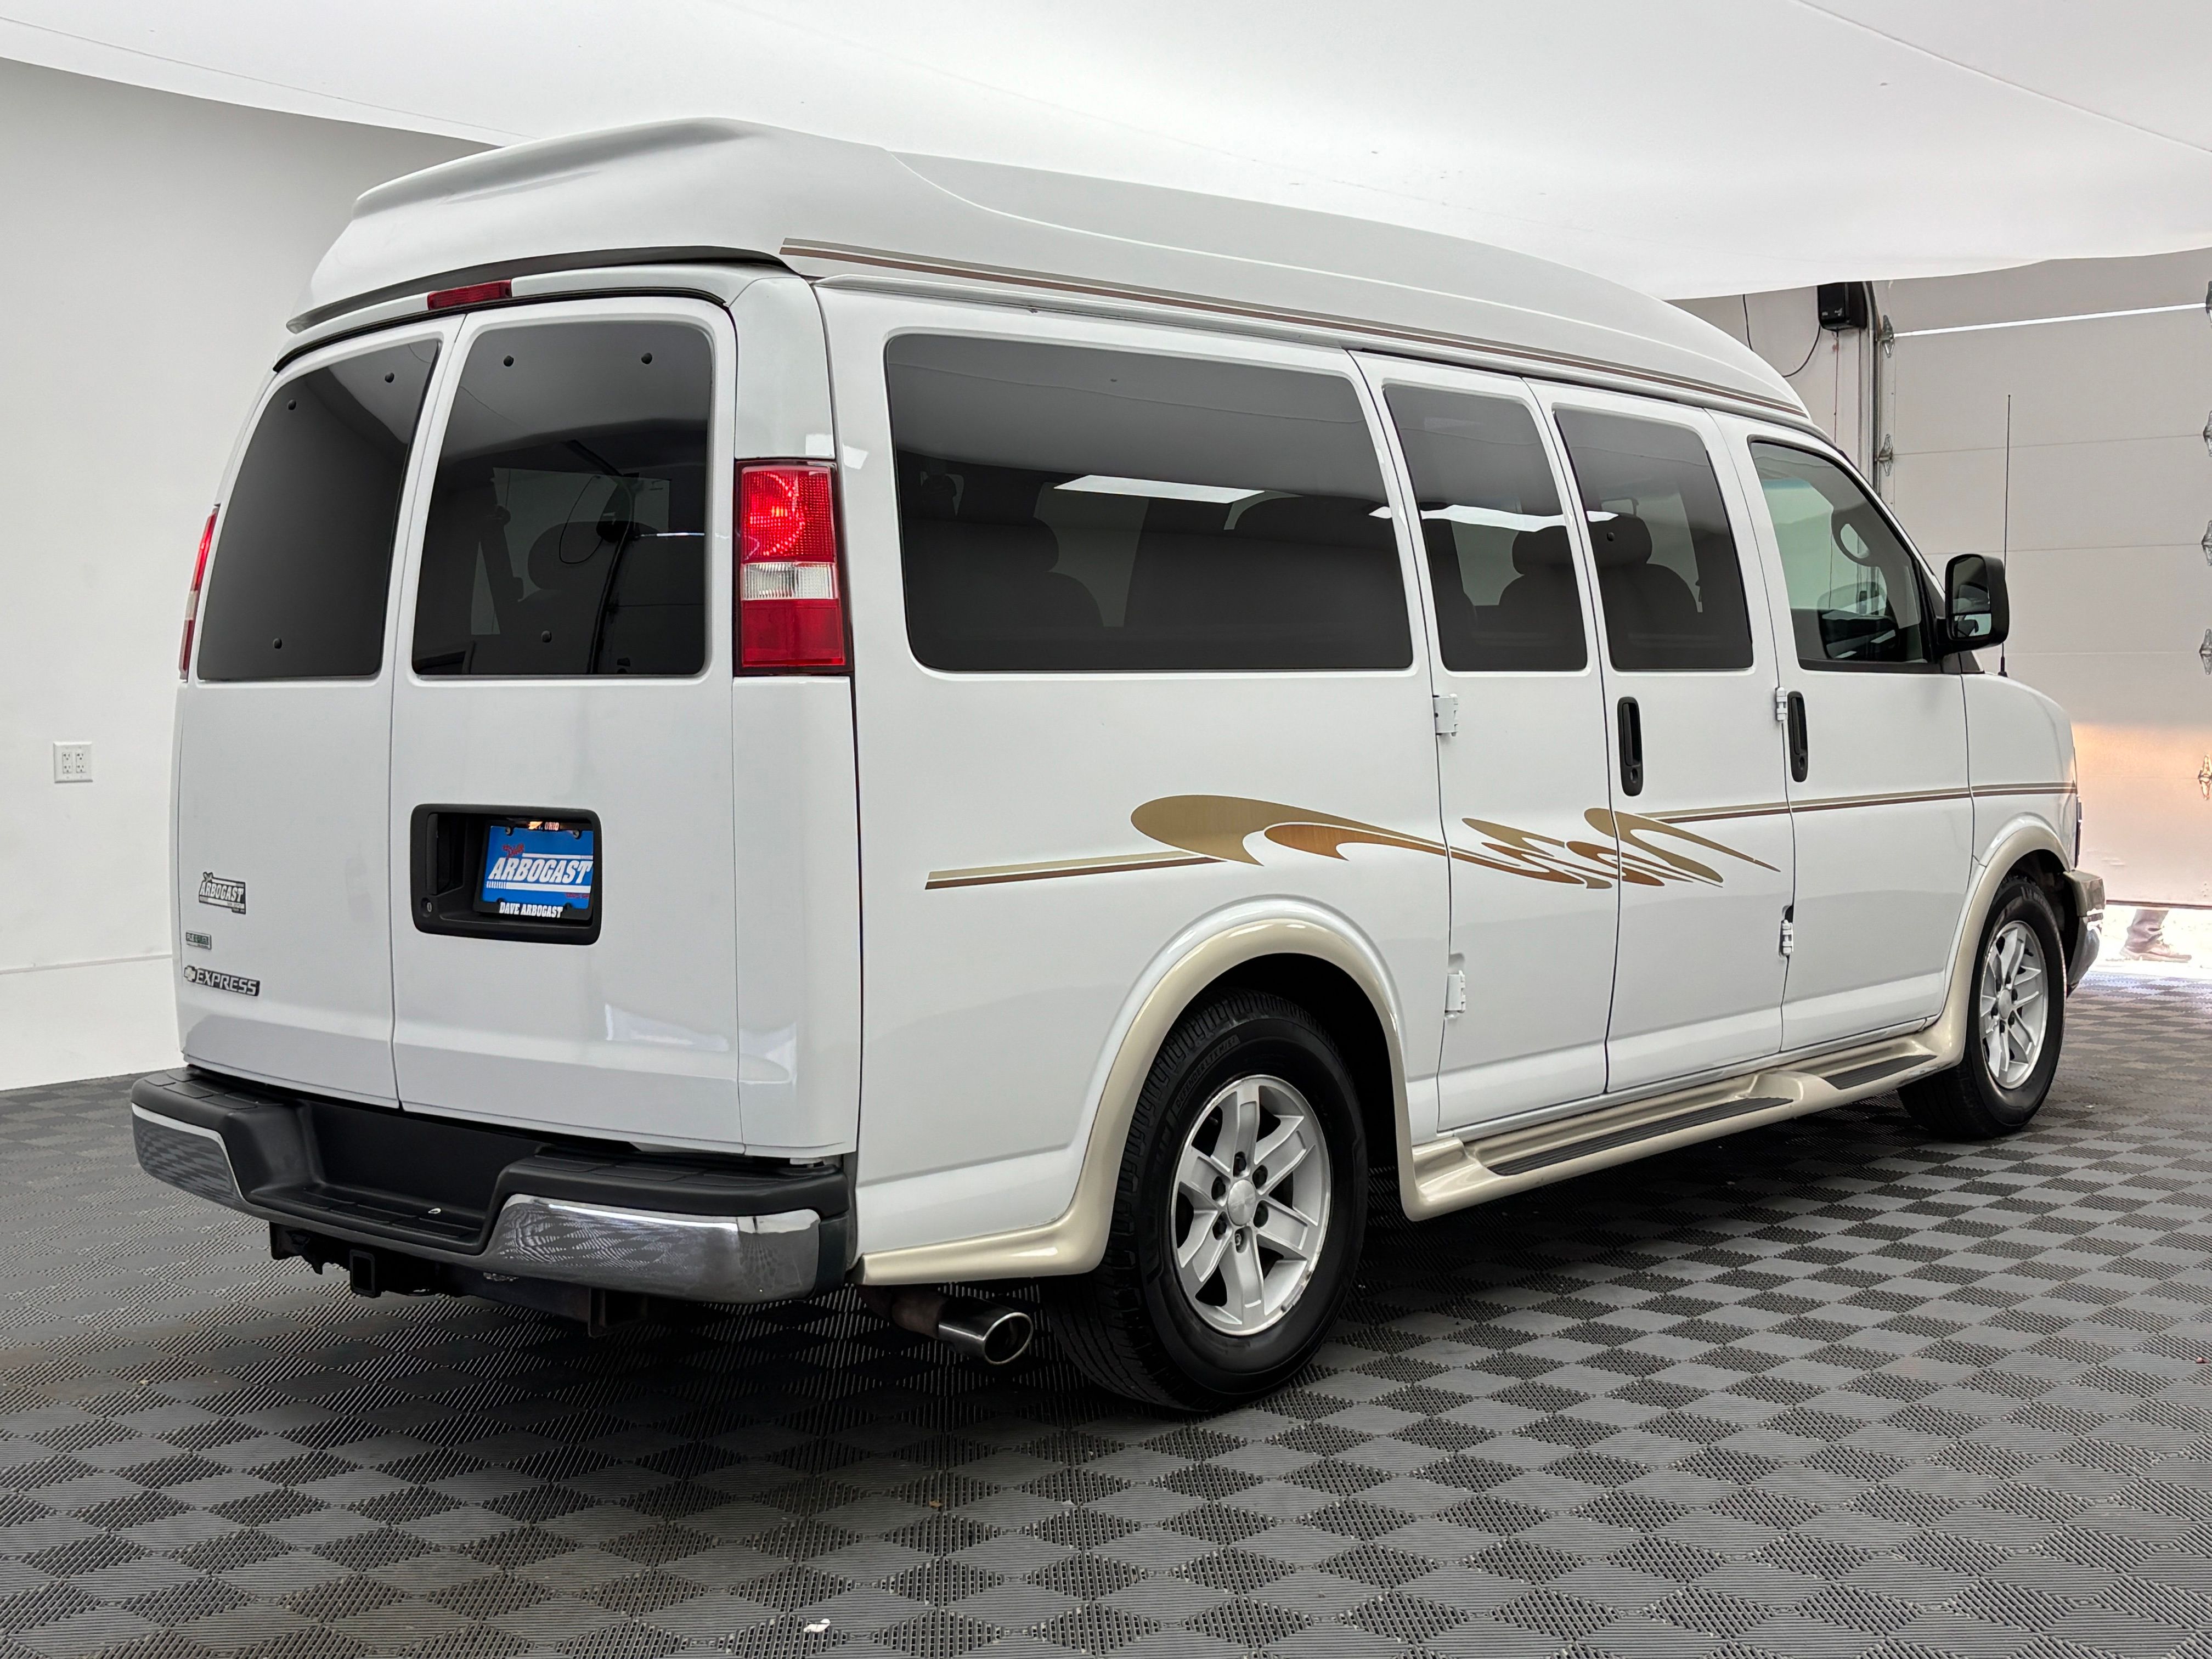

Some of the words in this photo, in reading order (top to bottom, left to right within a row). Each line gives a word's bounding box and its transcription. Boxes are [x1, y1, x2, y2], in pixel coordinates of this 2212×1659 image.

[545, 822, 559, 831] OHIO
[488, 857, 593, 884] ARBOGAST
[199, 881, 244, 902] ARBOGAST
[499, 902, 520, 915] DAVE
[521, 904, 563, 918] ARBOGAST
[195, 969, 257, 995] EXPRESS
[1176, 1063, 1205, 1107] DEFENDER
